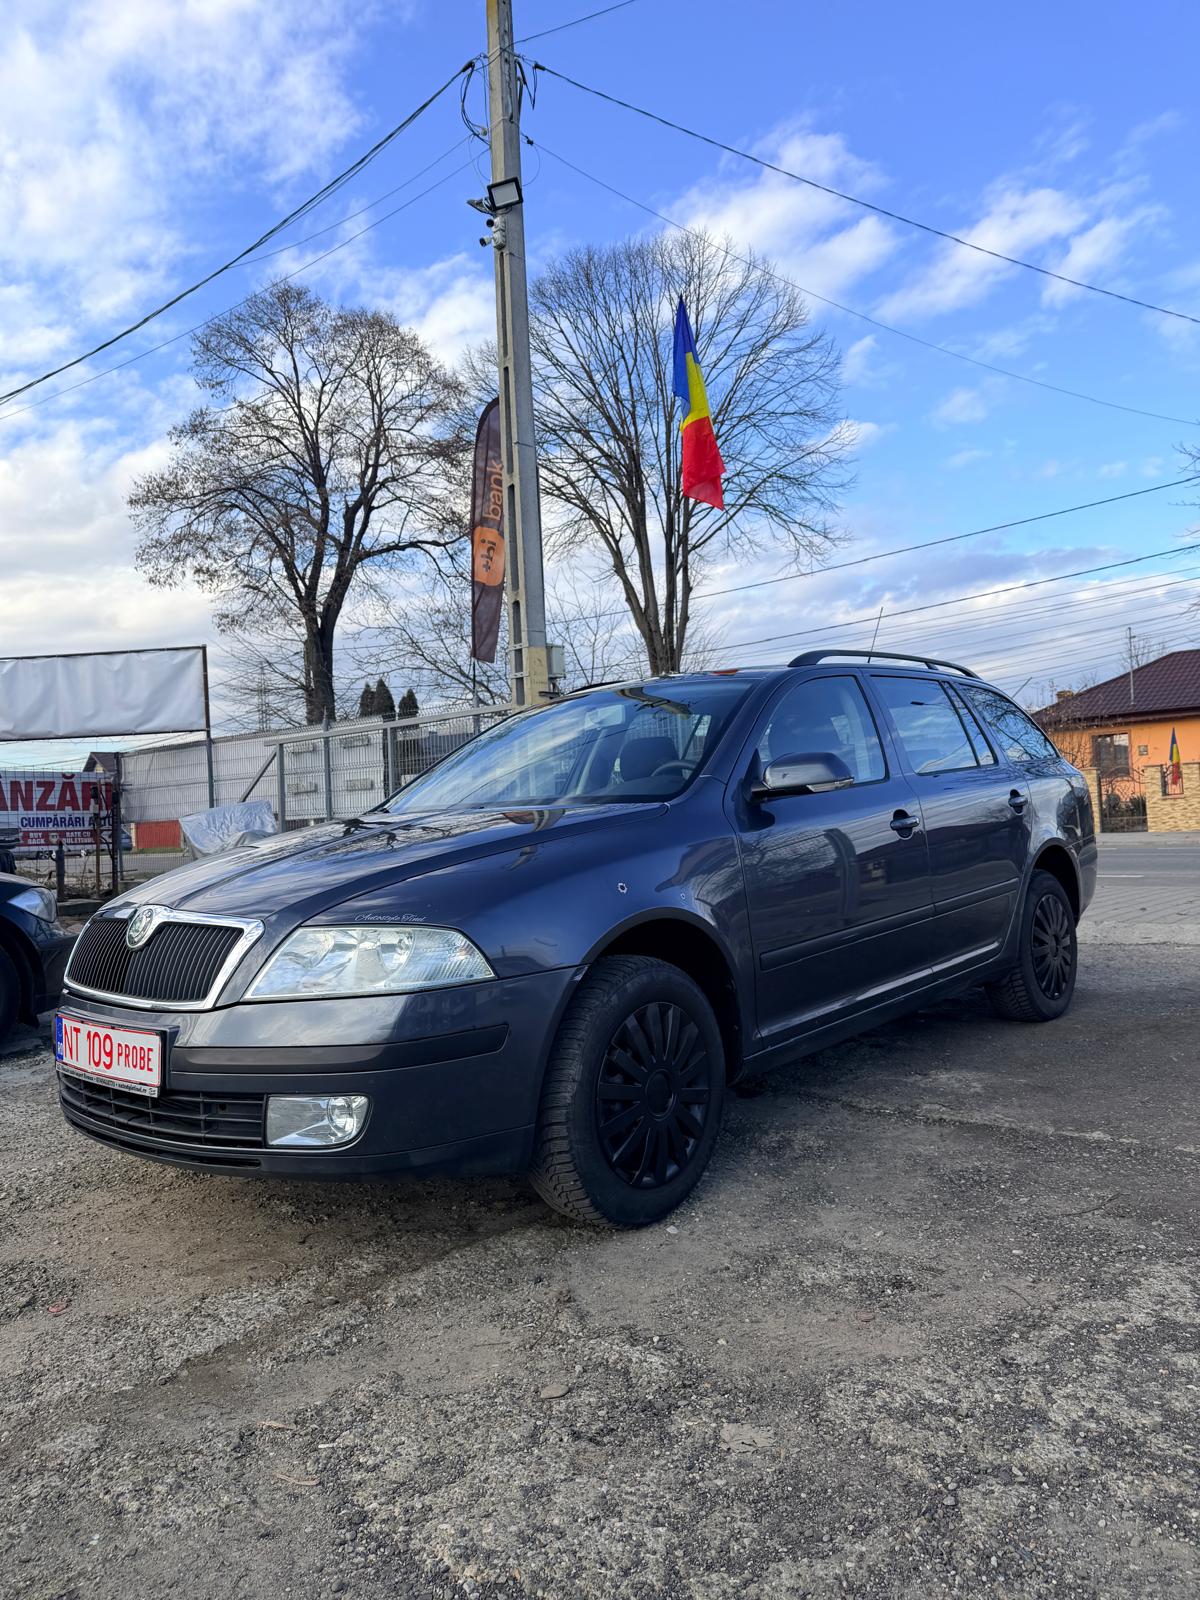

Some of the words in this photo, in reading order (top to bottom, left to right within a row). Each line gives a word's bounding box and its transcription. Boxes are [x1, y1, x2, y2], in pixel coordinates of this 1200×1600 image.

[483, 459, 503, 520] bank
[20, 814, 85, 828] CUMPĂRĂRI
[63, 1023, 81, 1062] NT
[86, 1029, 114, 1071] 109
[117, 1042, 154, 1073] PROBE
